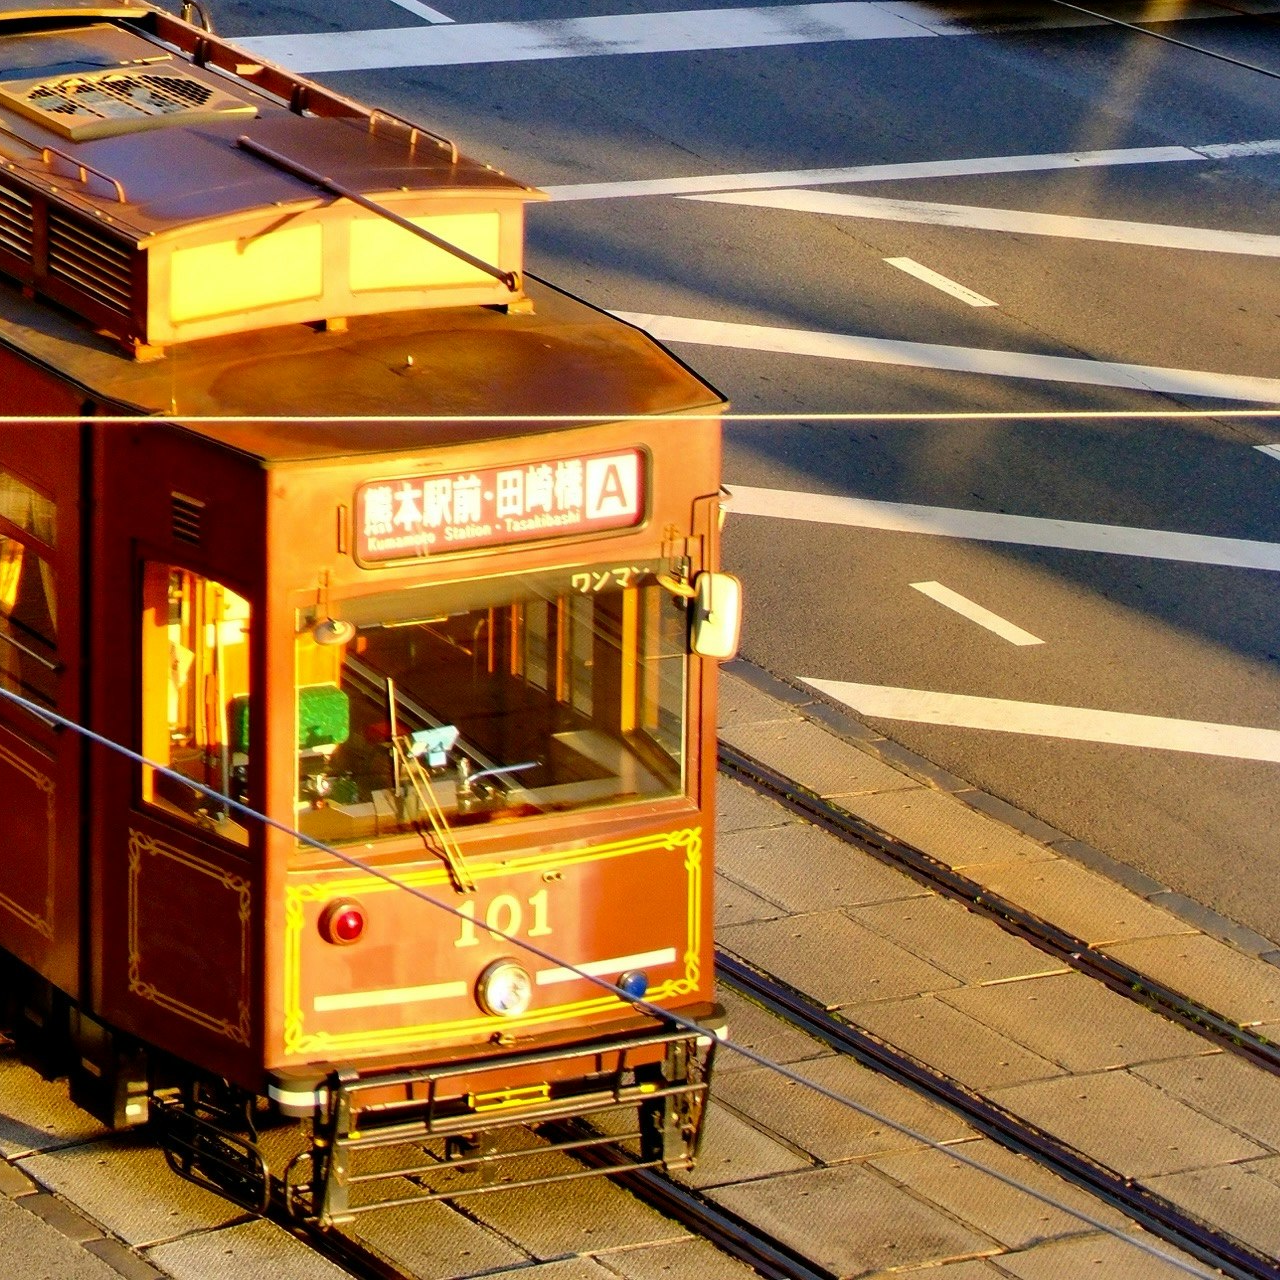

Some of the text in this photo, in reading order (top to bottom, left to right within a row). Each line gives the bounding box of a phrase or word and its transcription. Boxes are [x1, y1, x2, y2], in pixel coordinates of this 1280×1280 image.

[595, 464, 628, 511] A
[444, 523, 493, 542] Station
[453, 889, 552, 948] 101
